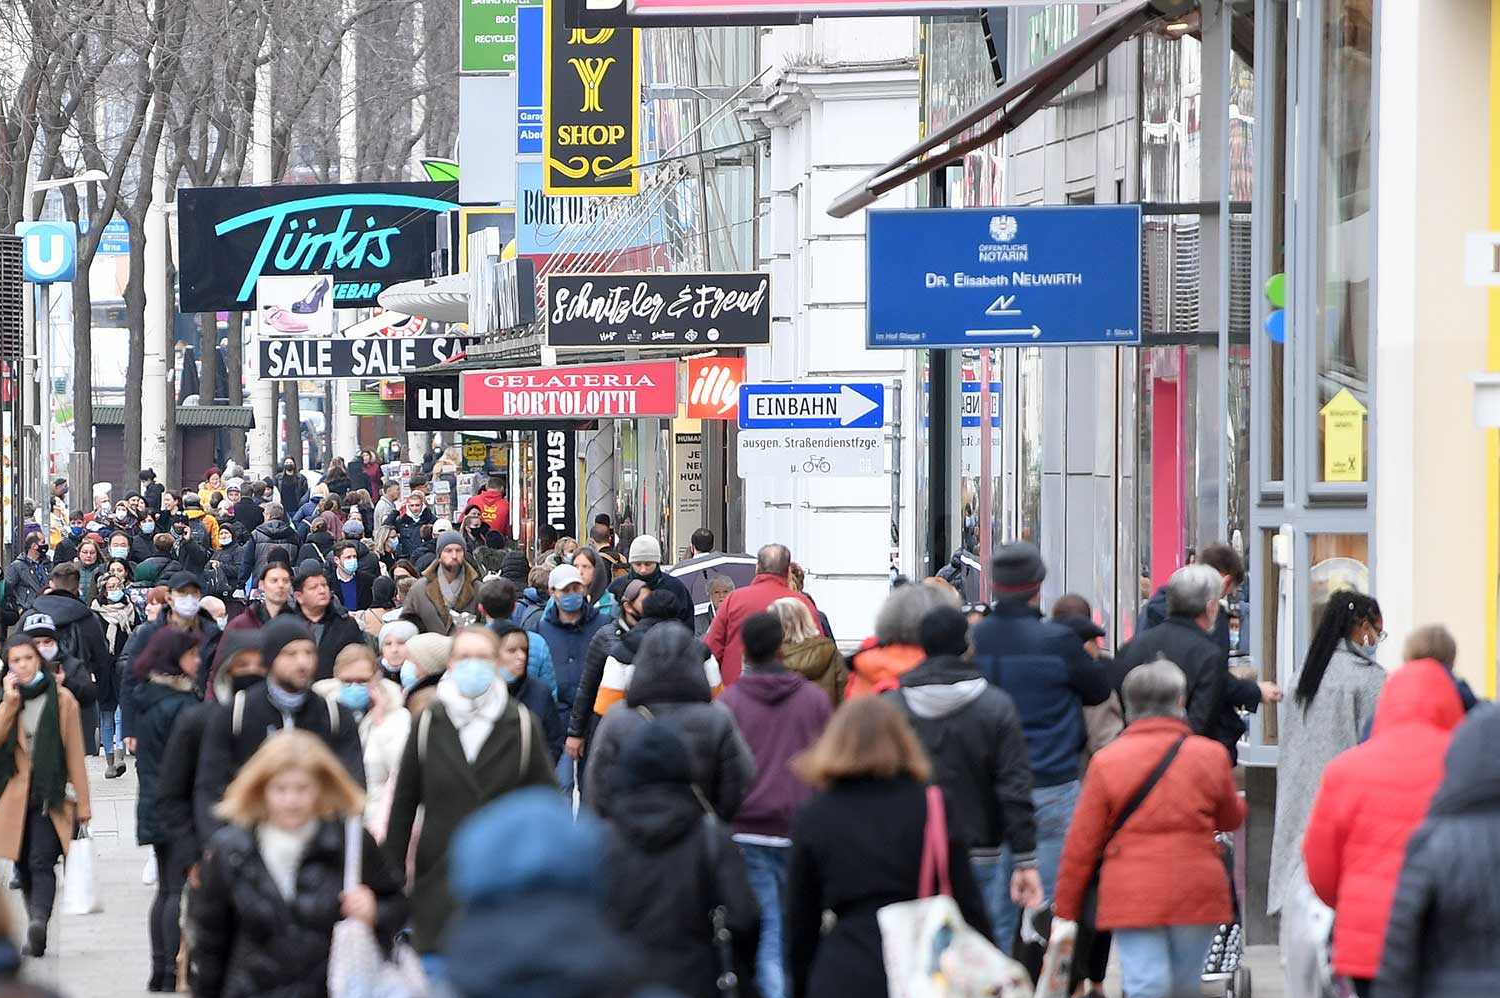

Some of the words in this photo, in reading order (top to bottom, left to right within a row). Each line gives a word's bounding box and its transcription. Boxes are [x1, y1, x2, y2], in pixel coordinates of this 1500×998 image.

[474, 34, 516, 43] RECYCLED
[557, 125, 625, 145] SHOP
[27, 234, 64, 275] U
[214, 193, 461, 302] Türkis
[978, 243, 1029, 252] ÖFFENTLICHE
[978, 251, 1029, 263] NOTARIN
[551, 281, 666, 325] Schnitzler
[667, 284, 693, 319] &
[693, 278, 768, 319] Freud
[1113, 327, 1135, 337] Stock
[268, 339, 333, 377] SALE
[351, 338, 416, 376] SALE
[483, 373, 656, 388] GELATERIA
[690, 364, 740, 415] illy
[418, 388, 459, 419] HU
[502, 390, 637, 416] BORTOLOTTI
[756, 397, 837, 416] EINBAHN
[742, 438, 782, 451] ausgen.
[784, 436, 881, 451] Straßendienstfzge.
